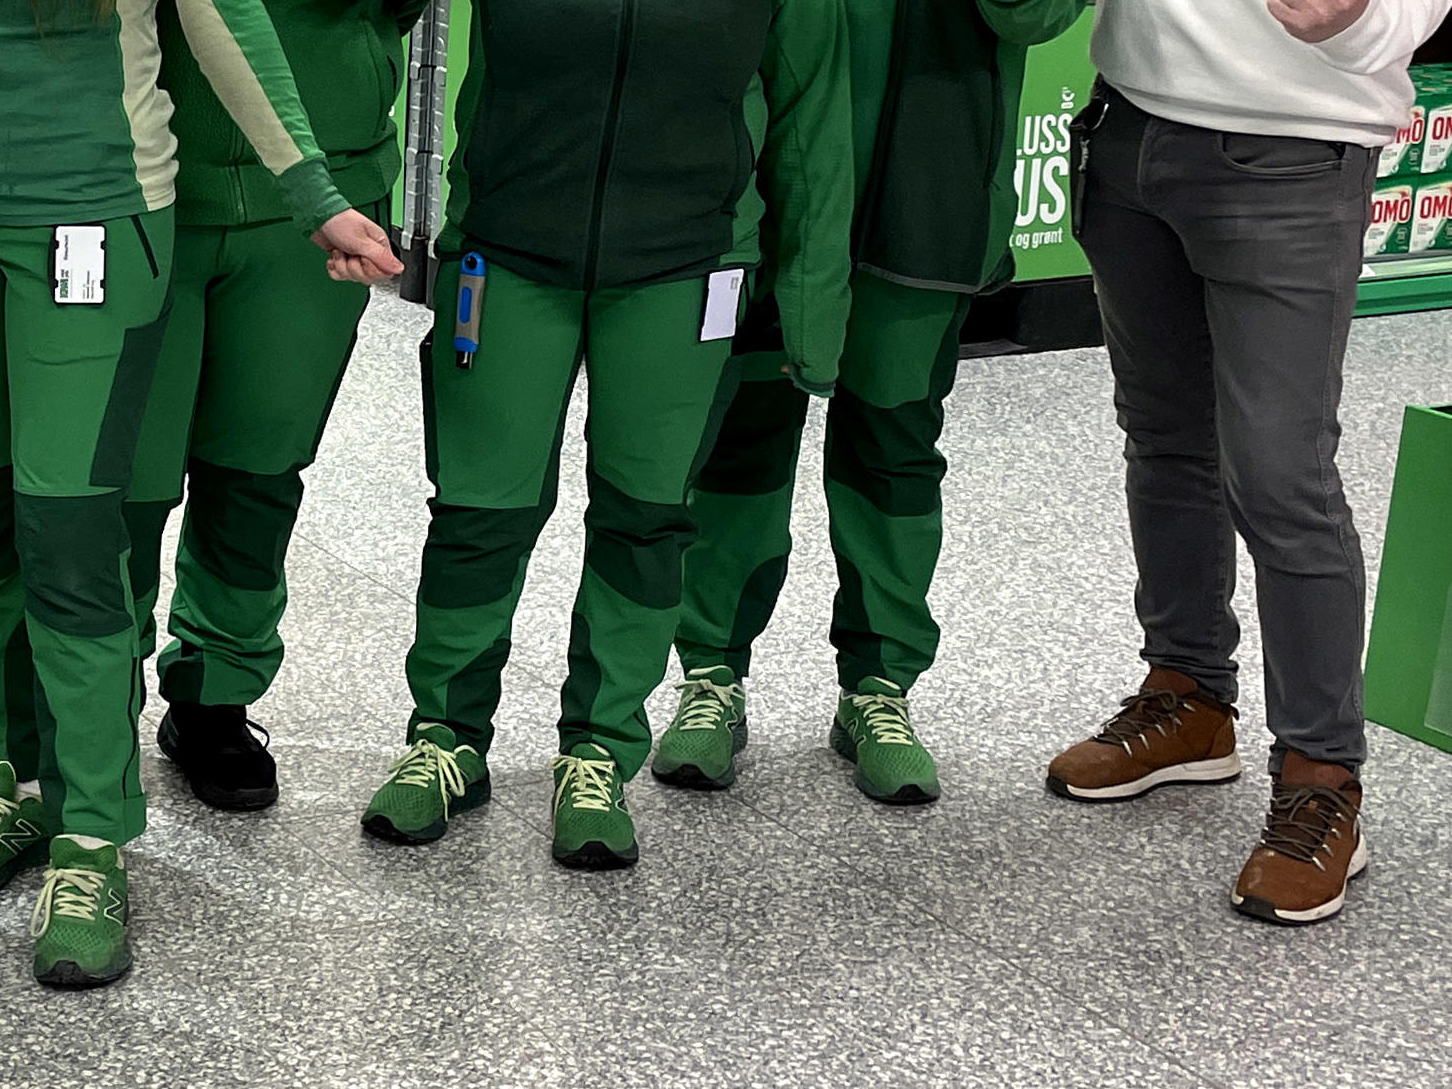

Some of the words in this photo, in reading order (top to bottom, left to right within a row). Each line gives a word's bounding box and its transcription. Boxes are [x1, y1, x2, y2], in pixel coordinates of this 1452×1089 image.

[1016, 113, 1074, 156] USS
[1372, 197, 1411, 223] OMO
[1015, 233, 1030, 250] og
[1032, 227, 1063, 249] grønt
